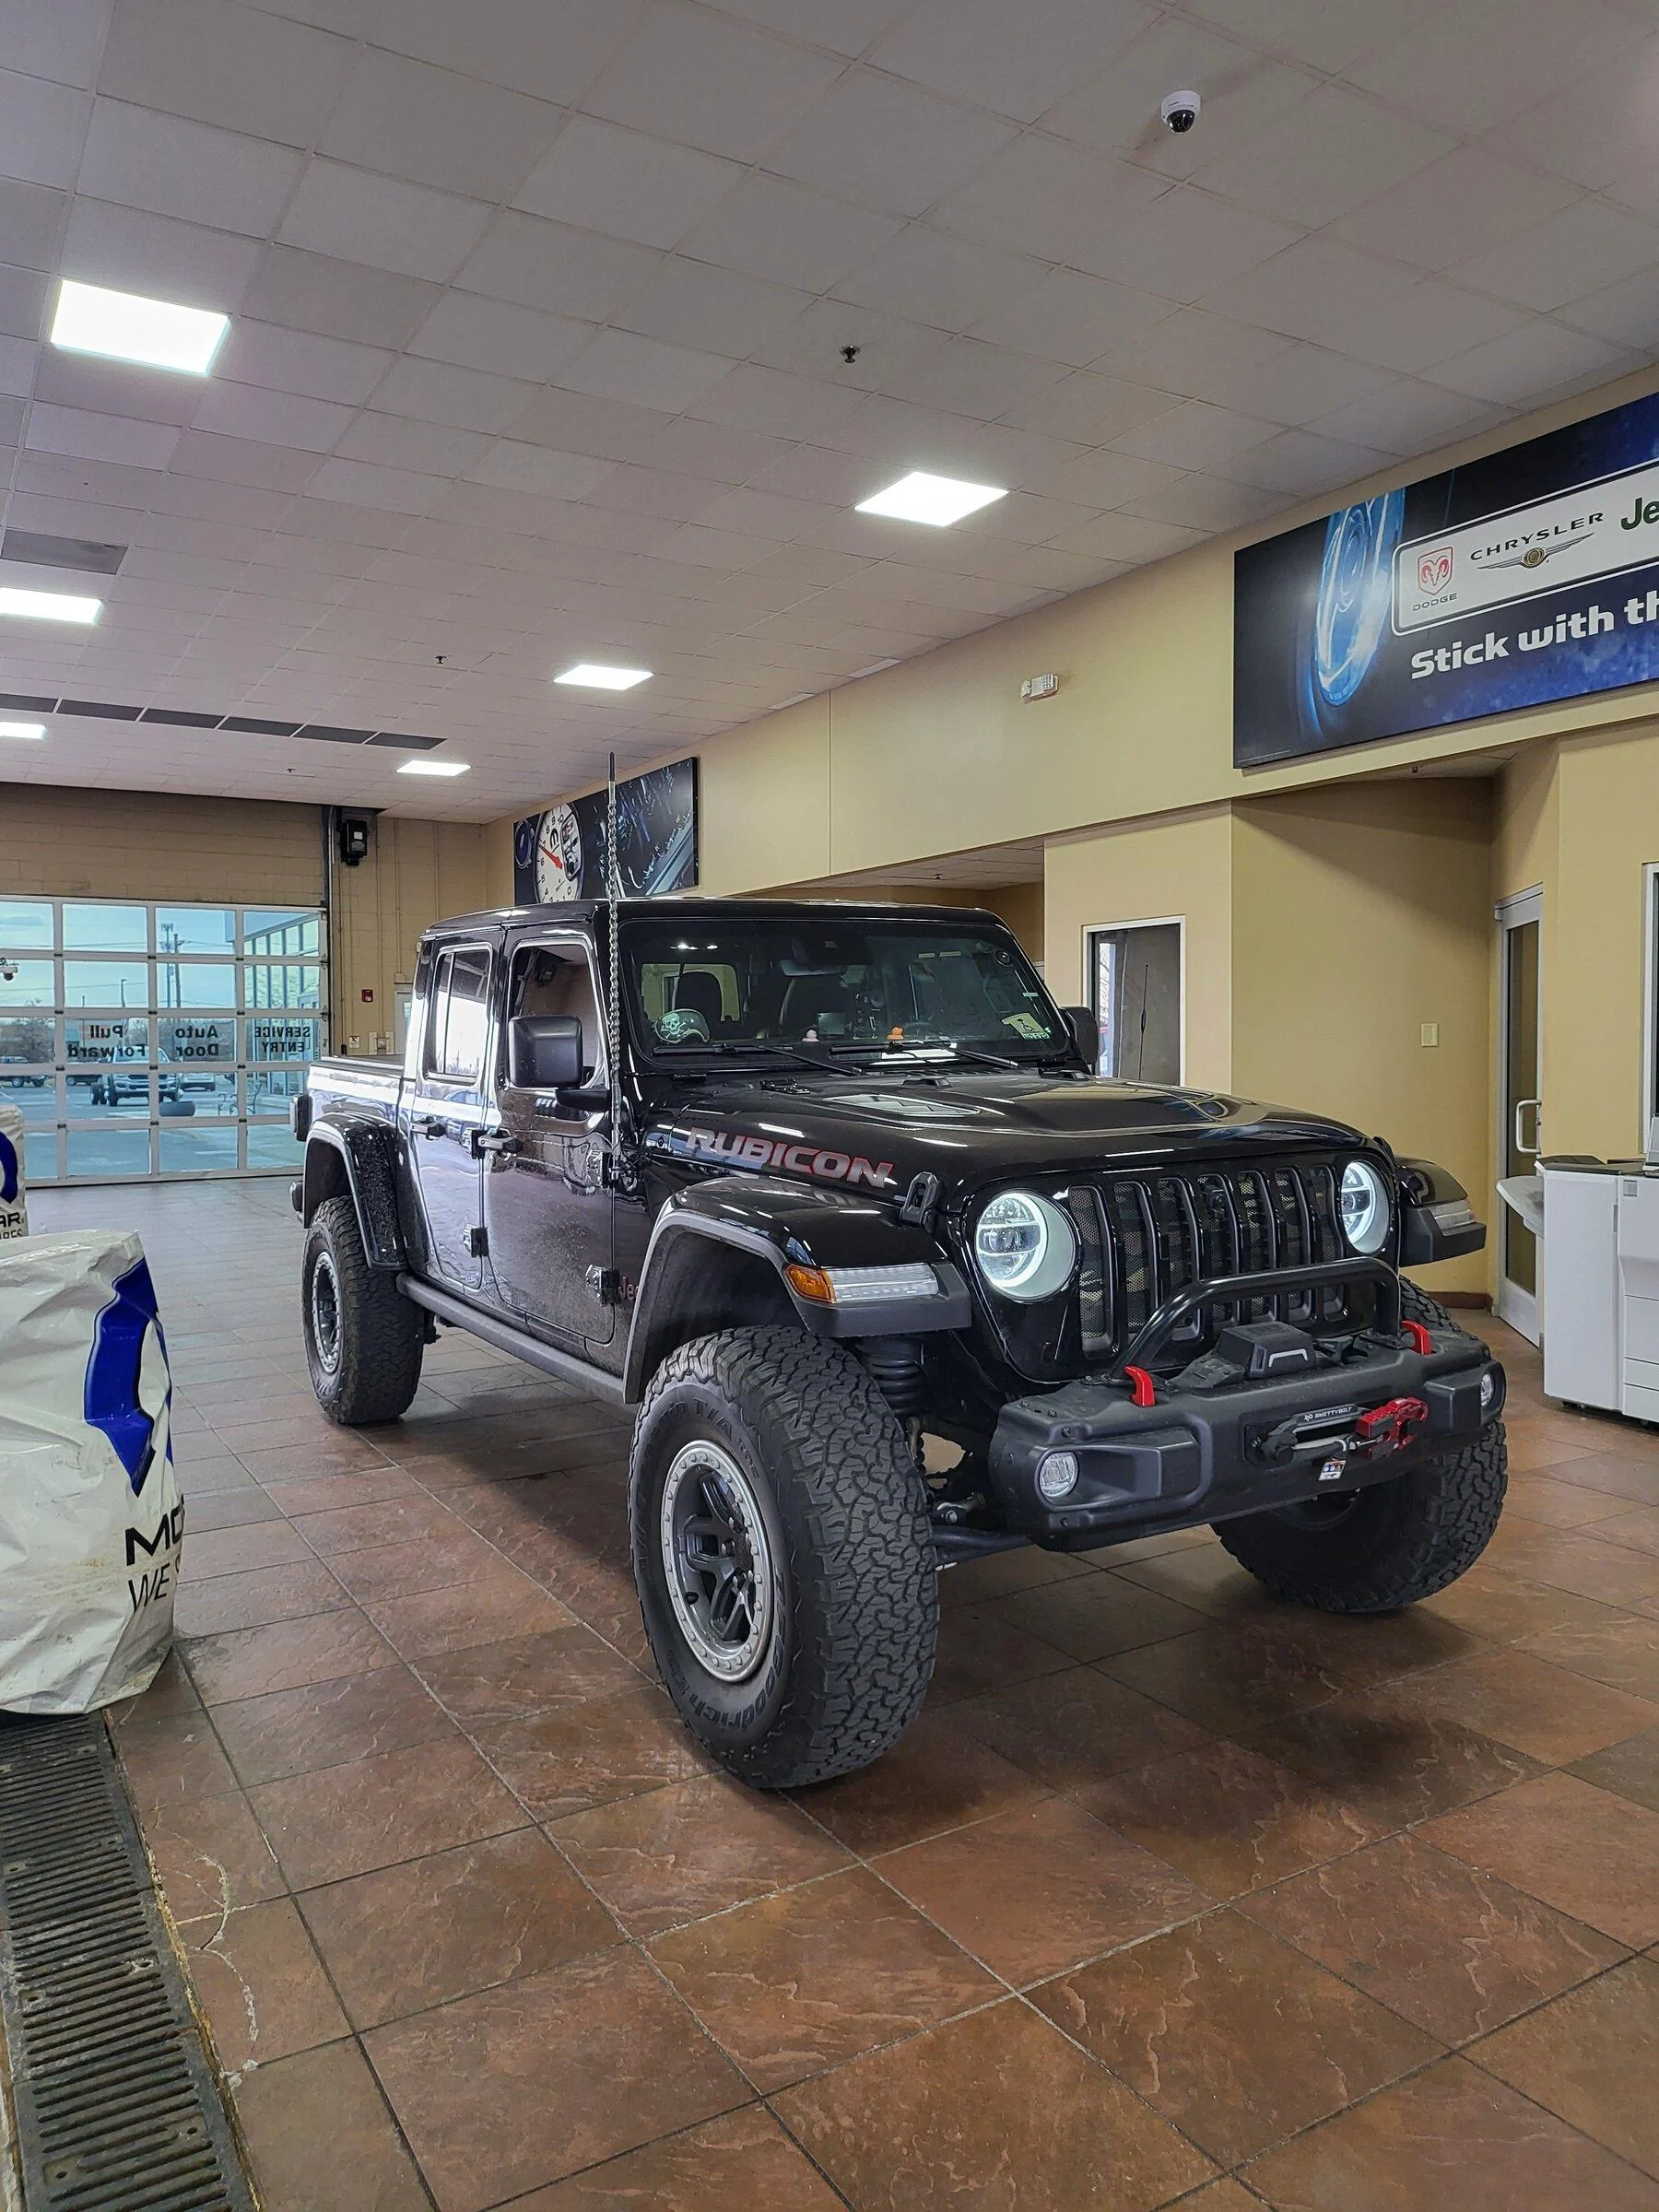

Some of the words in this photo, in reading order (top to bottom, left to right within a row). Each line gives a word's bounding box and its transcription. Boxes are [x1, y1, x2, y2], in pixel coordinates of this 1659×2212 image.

[1470, 512, 1604, 560] CHRYSLER
[1412, 593, 1458, 612] DODGE
[1410, 632, 1510, 680] Stick
[1518, 605, 1615, 652] with
[686, 1126, 894, 1189] RUBICON
[1314, 1406, 1352, 1418] SMITTYBILT
